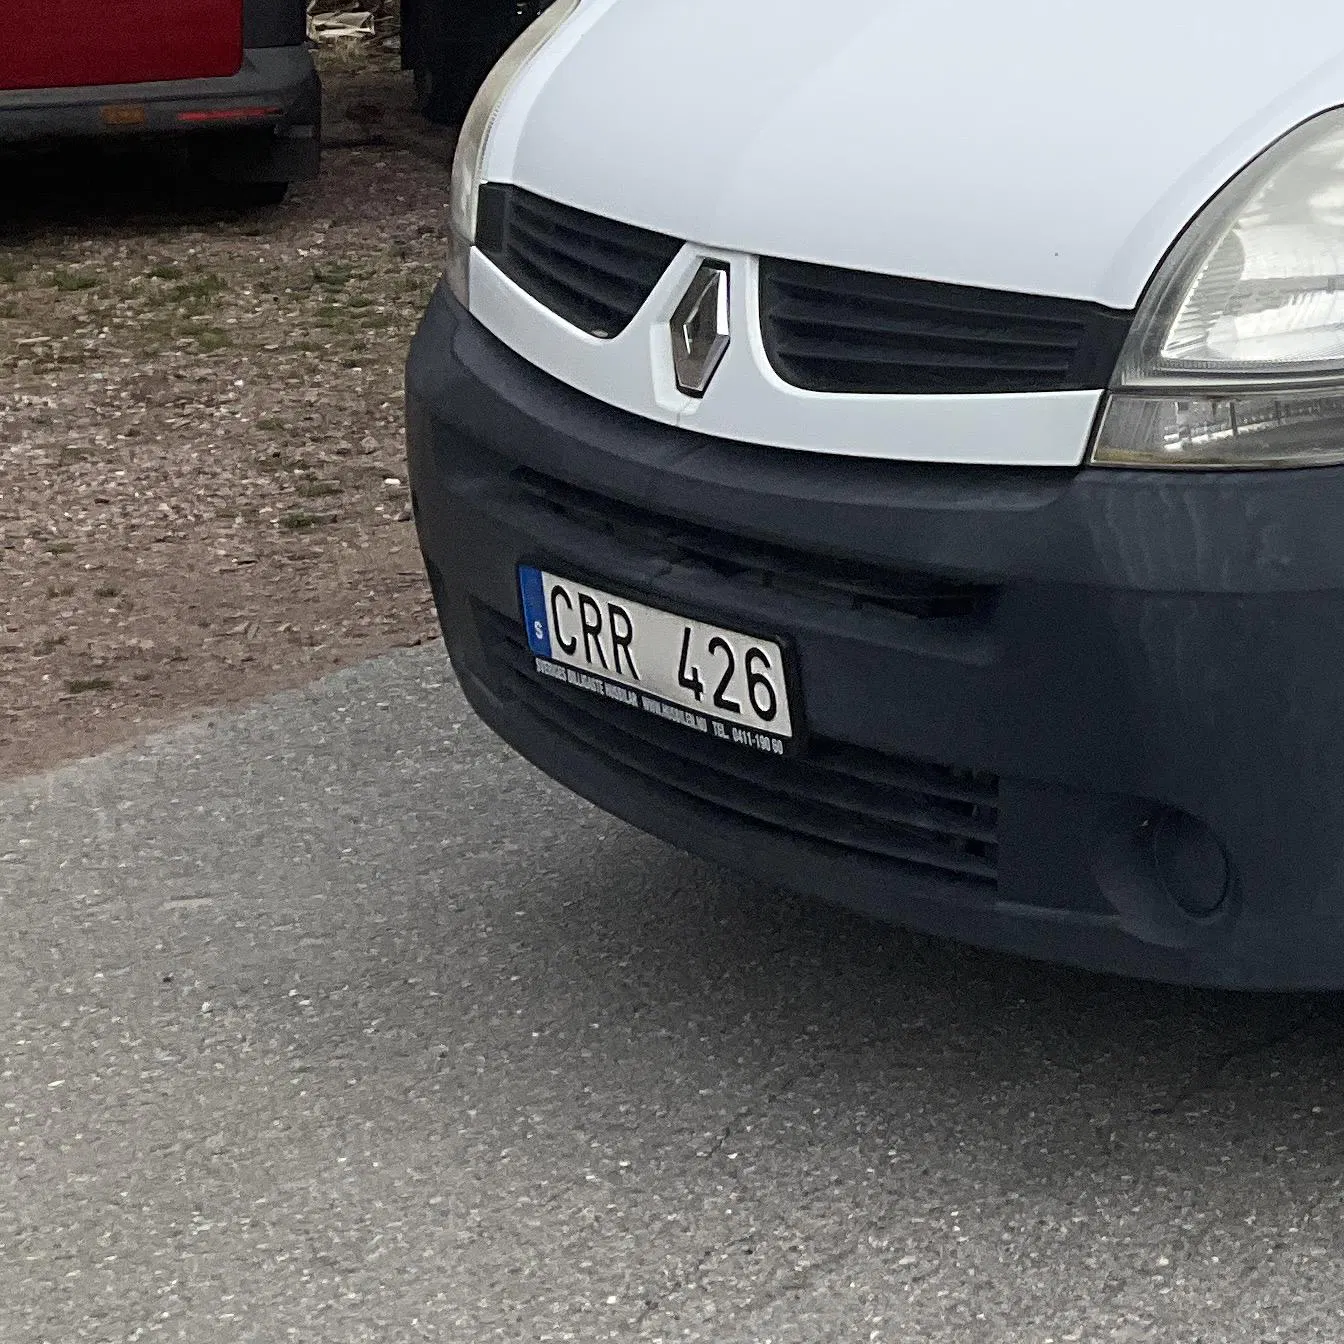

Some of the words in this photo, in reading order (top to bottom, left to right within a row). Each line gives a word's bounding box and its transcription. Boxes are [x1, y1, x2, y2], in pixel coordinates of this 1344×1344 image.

[535, 621, 544, 640] S
[550, 584, 641, 682] CRR
[677, 626, 778, 722] 426
